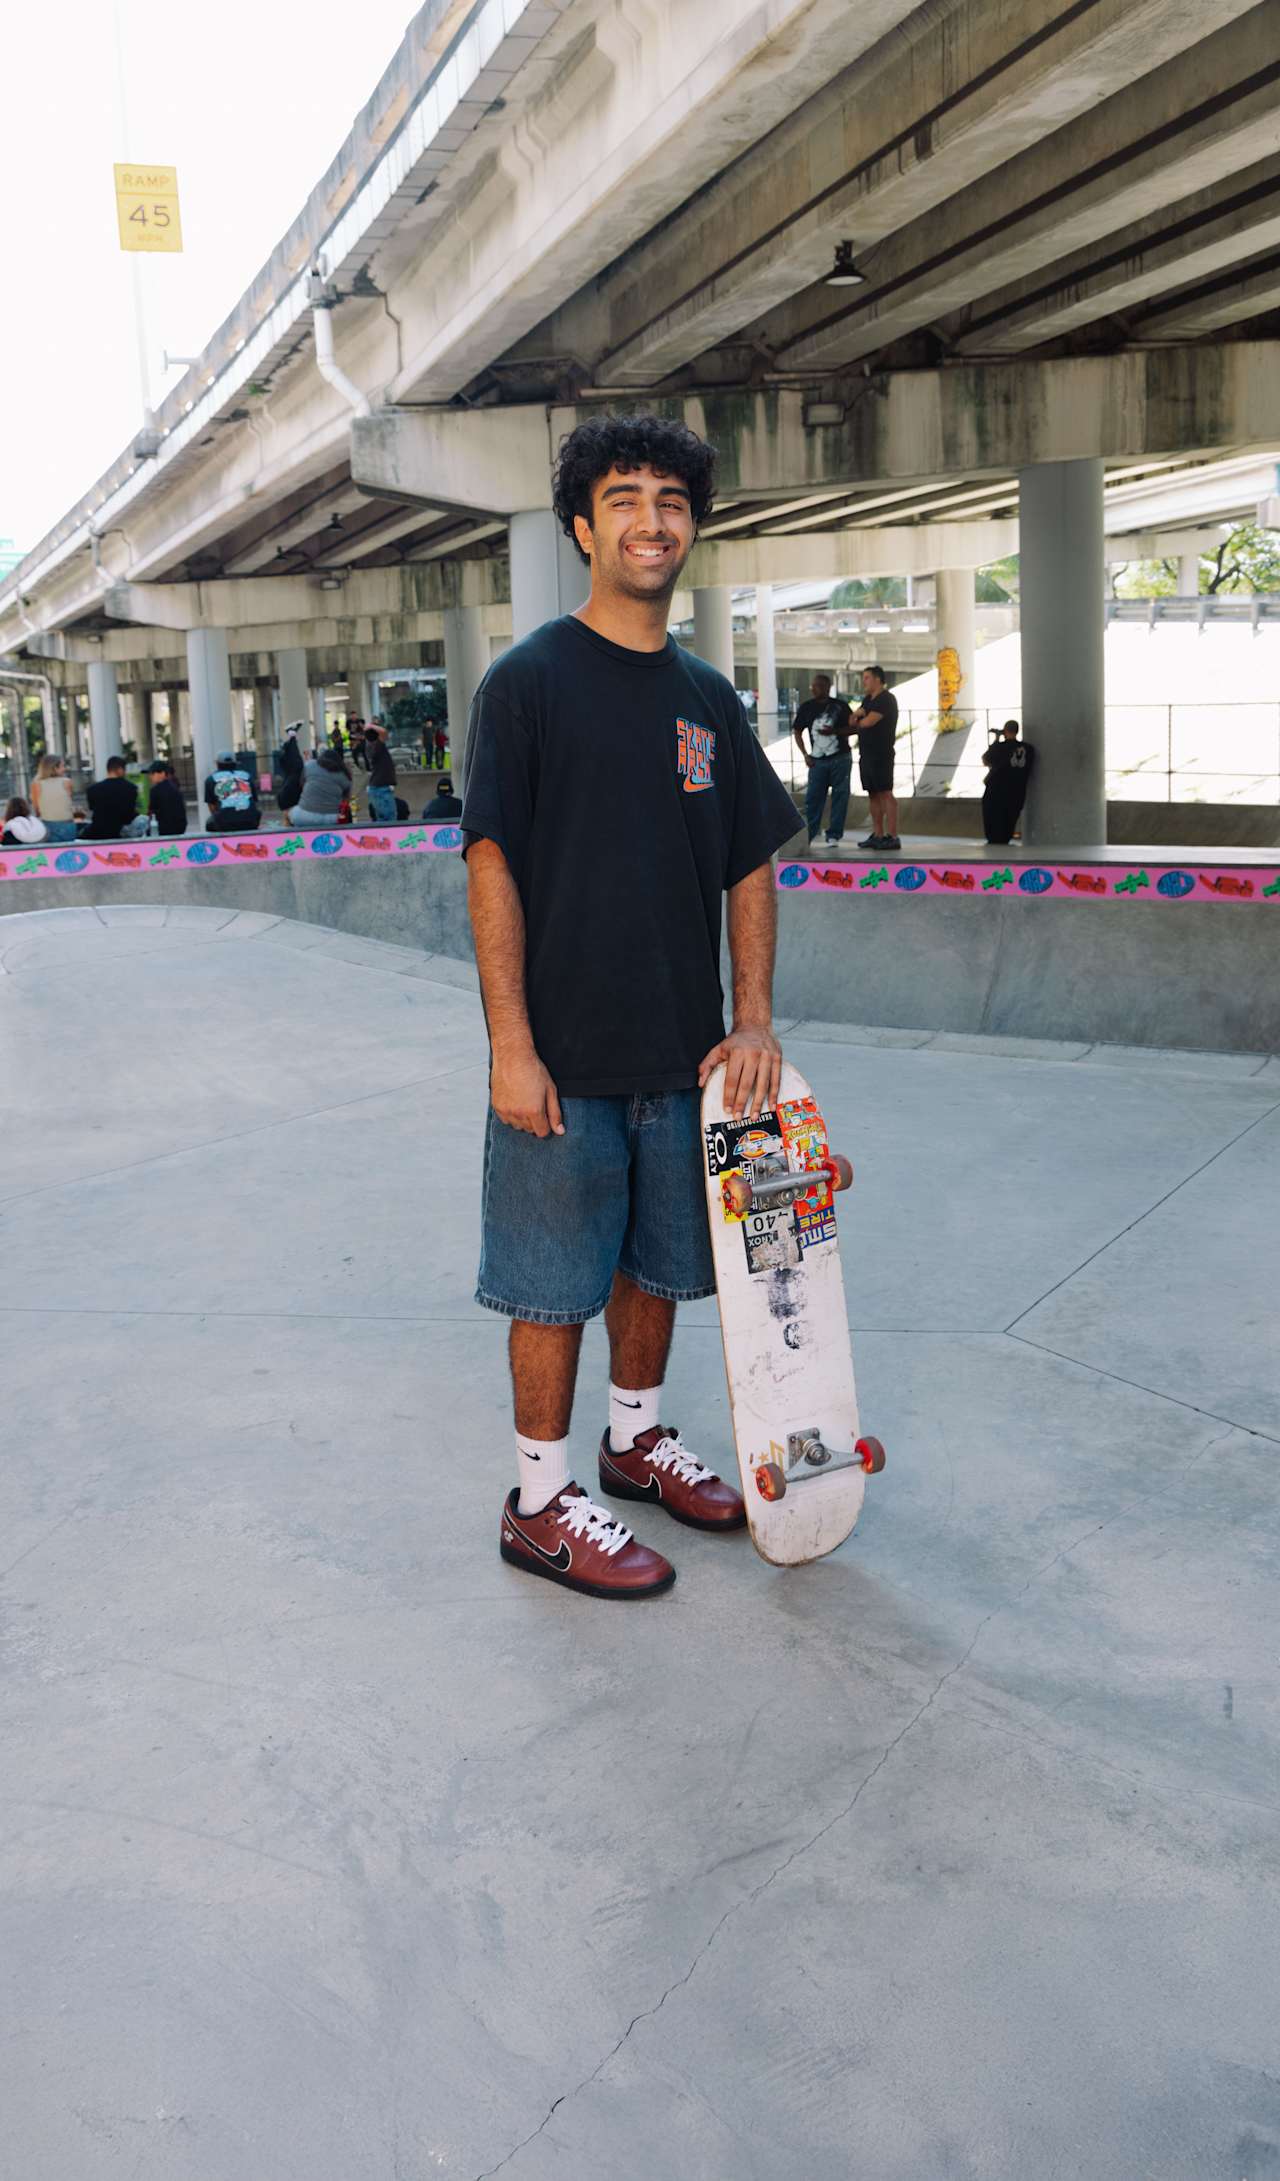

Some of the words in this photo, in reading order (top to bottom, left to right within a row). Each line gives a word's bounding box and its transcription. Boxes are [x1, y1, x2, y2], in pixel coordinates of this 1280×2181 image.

[122, 174, 171, 188] RAMP
[128, 204, 171, 228] 45
[705, 1125, 717, 1173] OAKLEY
[800, 1209, 833, 1229] TIRE
[748, 1232, 775, 1248] KNOX
